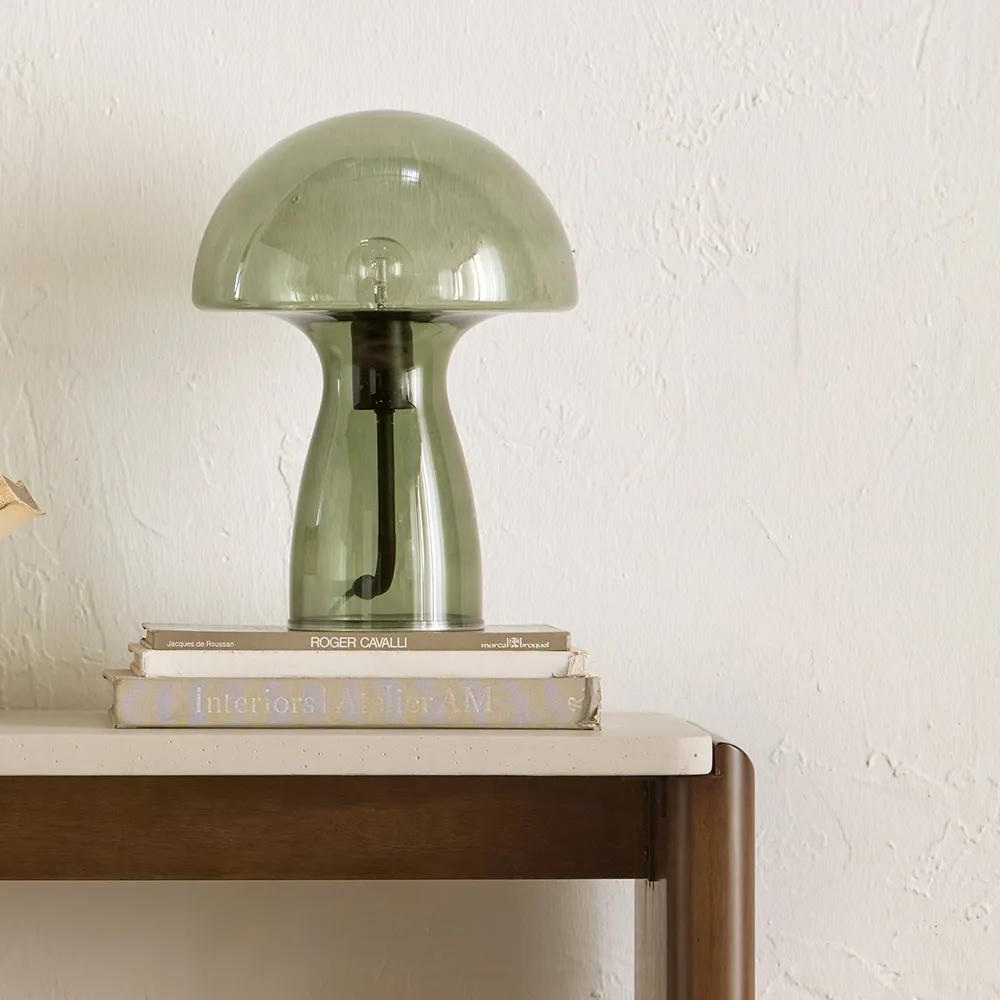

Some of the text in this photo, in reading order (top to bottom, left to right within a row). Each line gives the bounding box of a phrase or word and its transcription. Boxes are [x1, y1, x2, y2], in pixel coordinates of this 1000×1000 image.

[166, 640, 195, 649] Jacques
[195, 640, 205, 648] de
[310, 636, 408, 648] ROGER CAVALLI
[194, 686, 316, 714] Interiors
